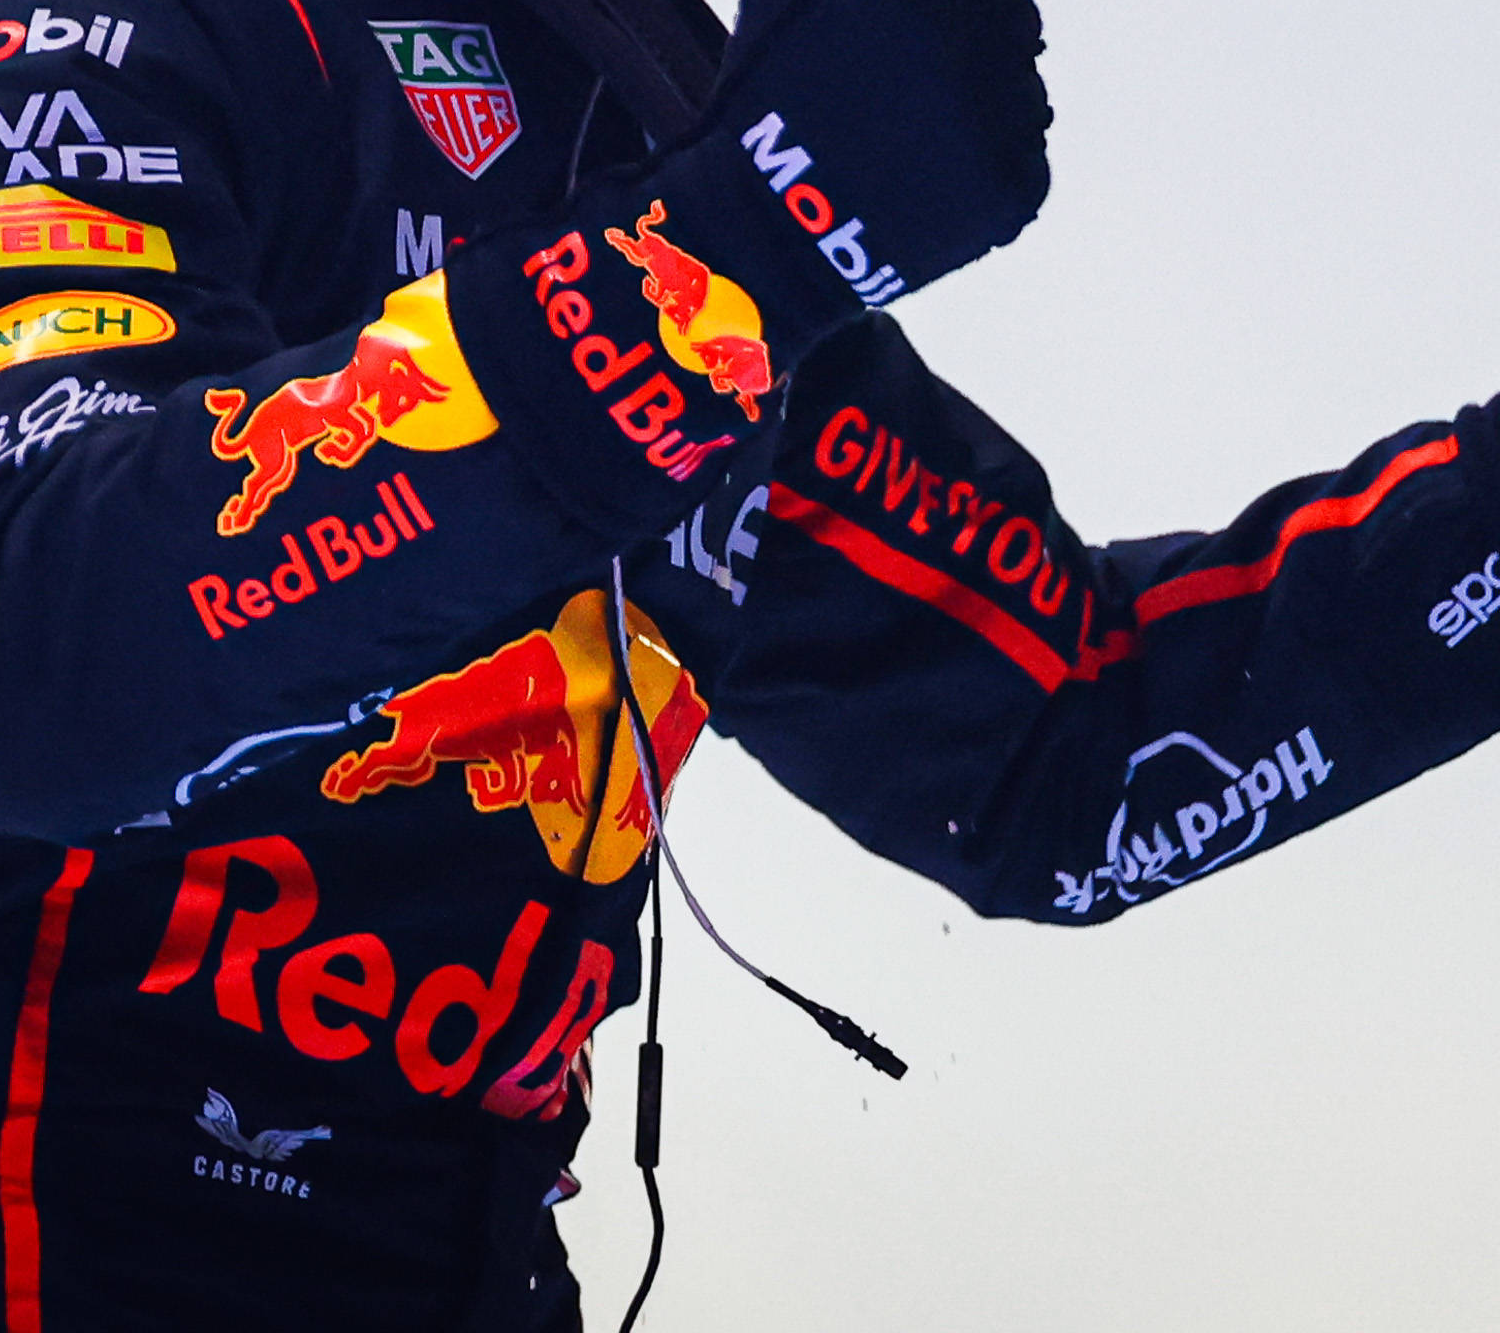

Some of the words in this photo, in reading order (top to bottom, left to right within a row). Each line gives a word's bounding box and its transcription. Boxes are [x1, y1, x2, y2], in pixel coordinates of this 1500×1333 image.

[375, 33, 493, 76] TAG
[414, 92, 511, 165] EUER
[740, 111, 905, 305] Mobil
[522, 231, 653, 393] Red
[187, 533, 318, 640] Red
[306, 471, 436, 582] Bull
[1175, 726, 1334, 860] Hard
[138, 834, 551, 1098] Red
[193, 1155, 311, 1199] CASTORE
